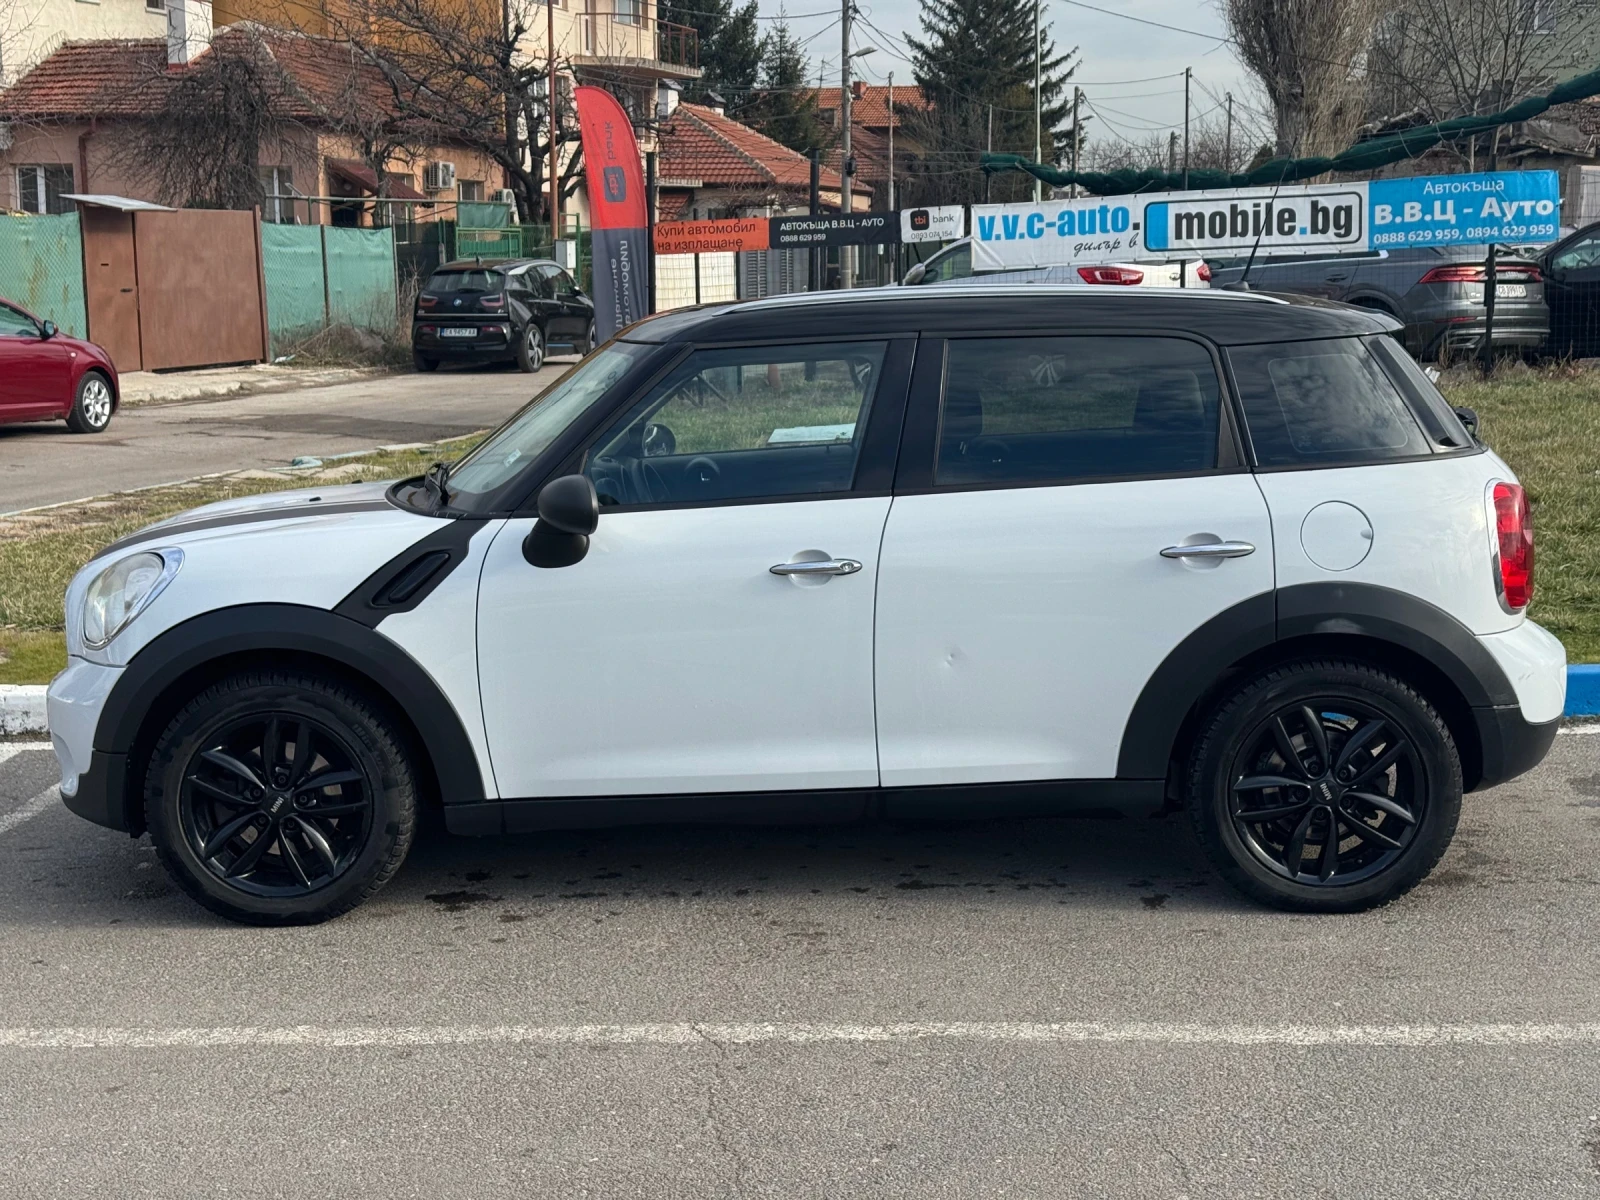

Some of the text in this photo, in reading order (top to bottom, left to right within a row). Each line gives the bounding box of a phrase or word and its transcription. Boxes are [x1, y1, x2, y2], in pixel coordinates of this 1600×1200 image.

[1423, 179, 1505, 195] Автокъща
[1374, 199, 1456, 225] В.В.Ц
[1480, 197, 1554, 222] Ауто
[780, 220, 830, 231] АВТОКЪЩА
[831, 219, 855, 229] В.В.Ц
[861, 217, 885, 227] АУТО
[913, 214, 954, 225] tbi bank
[1174, 200, 1353, 240] mobile.bg
[657, 222, 756, 238] Купи автомобил
[780, 234, 798, 242] 0888
[799, 233, 812, 241] 629
[1374, 224, 1554, 244] 0888 629 959, 0894 629 959
[657, 238, 743, 250] на изплащане
[1320, 782, 1332, 800] MINI
[270, 796, 284, 813] MINI
